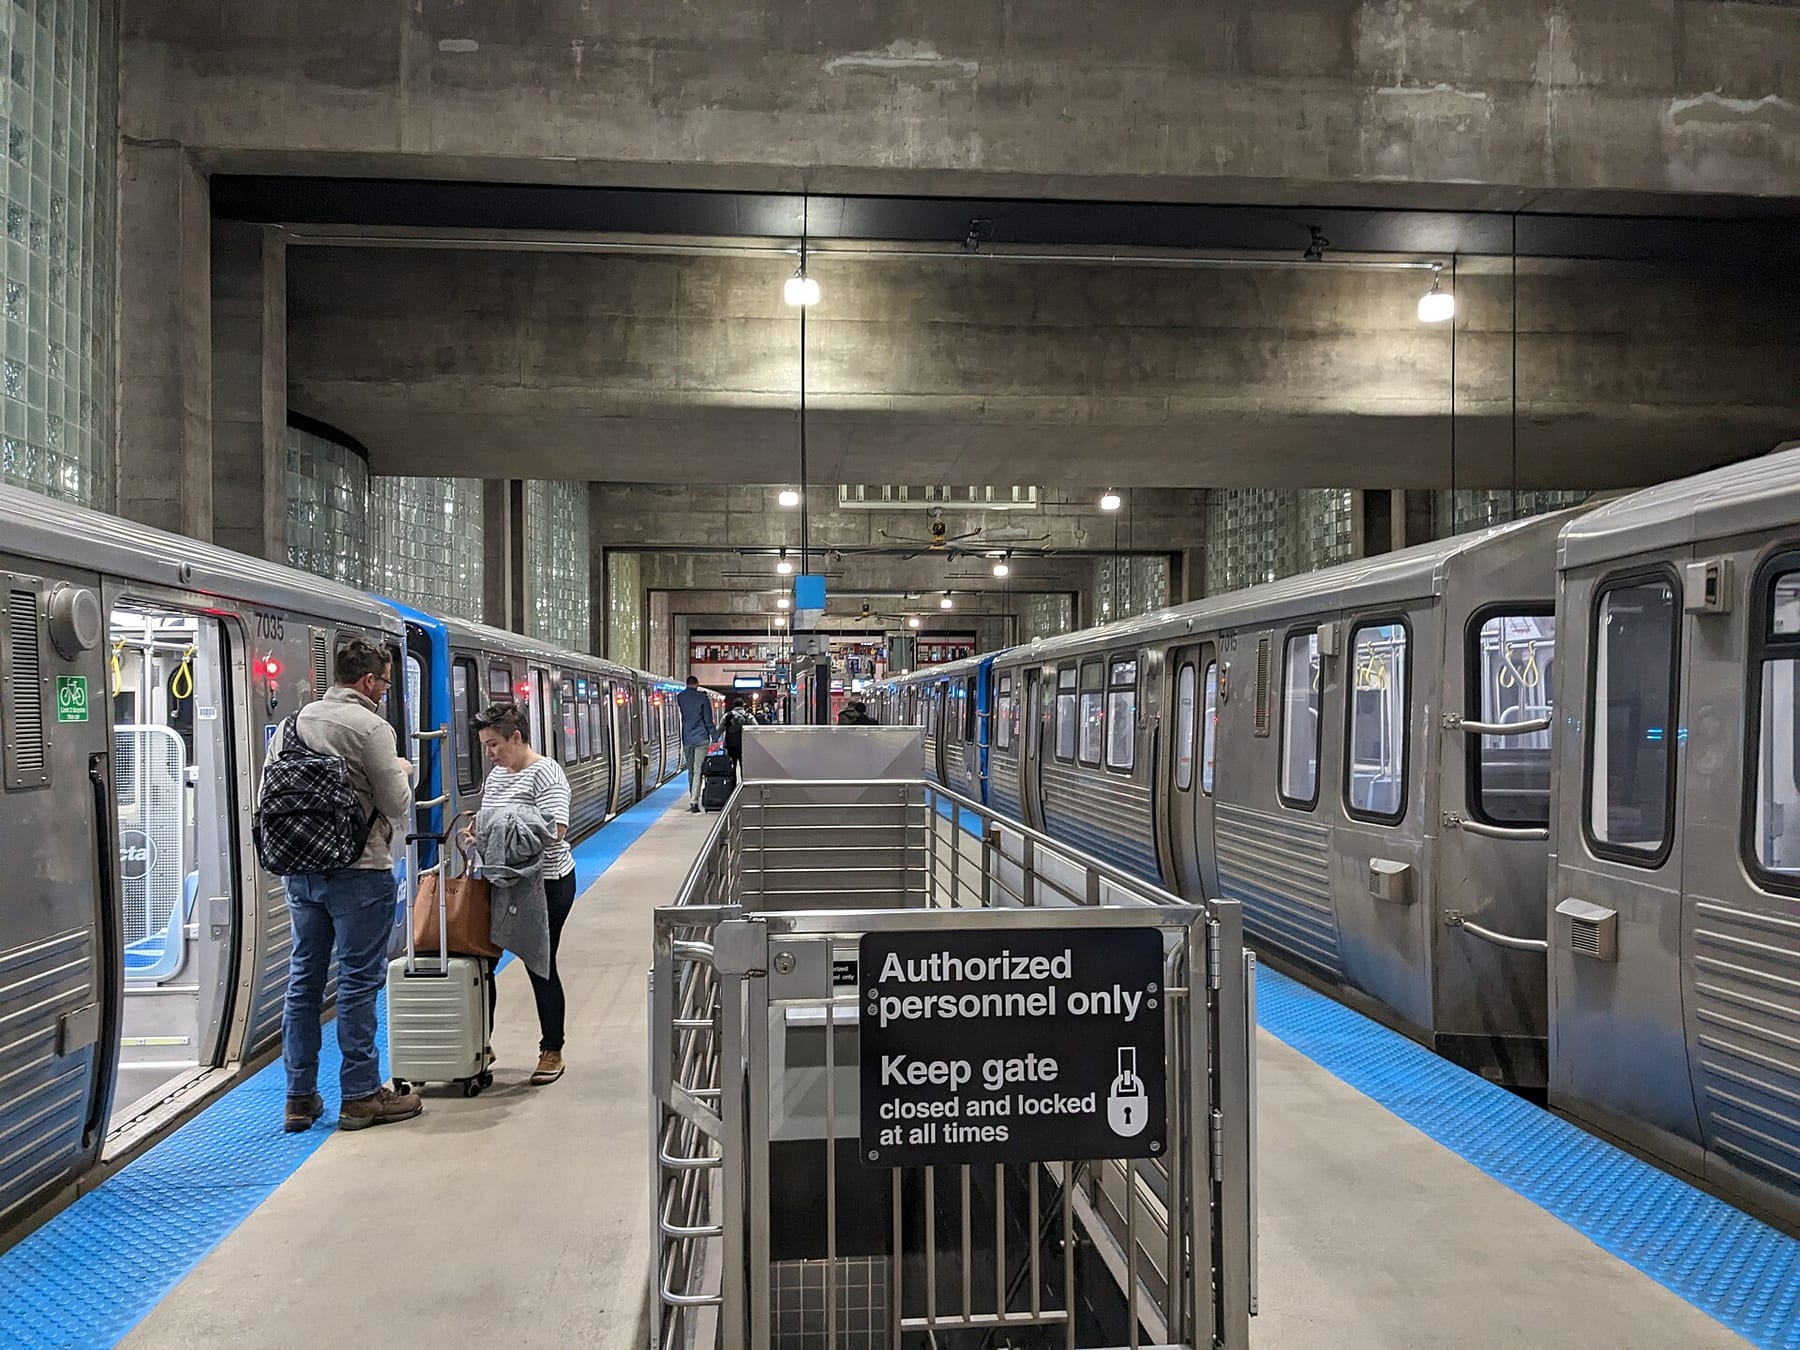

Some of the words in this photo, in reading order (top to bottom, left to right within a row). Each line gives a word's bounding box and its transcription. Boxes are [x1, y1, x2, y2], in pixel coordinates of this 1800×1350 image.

[254, 611, 284, 641] 7035
[878, 949, 1072, 983] Authorized
[879, 986, 1056, 1028] personnel
[1067, 984, 1143, 1022] only
[881, 1055, 972, 1091] Keep
[982, 1053, 1059, 1091] gate
[879, 1097, 959, 1119] closed
[966, 1095, 1011, 1117] and
[1018, 1092, 1096, 1115] locked
[879, 1124, 903, 1145] at
[909, 1124, 936, 1144] all
[942, 1122, 1009, 1143] times
